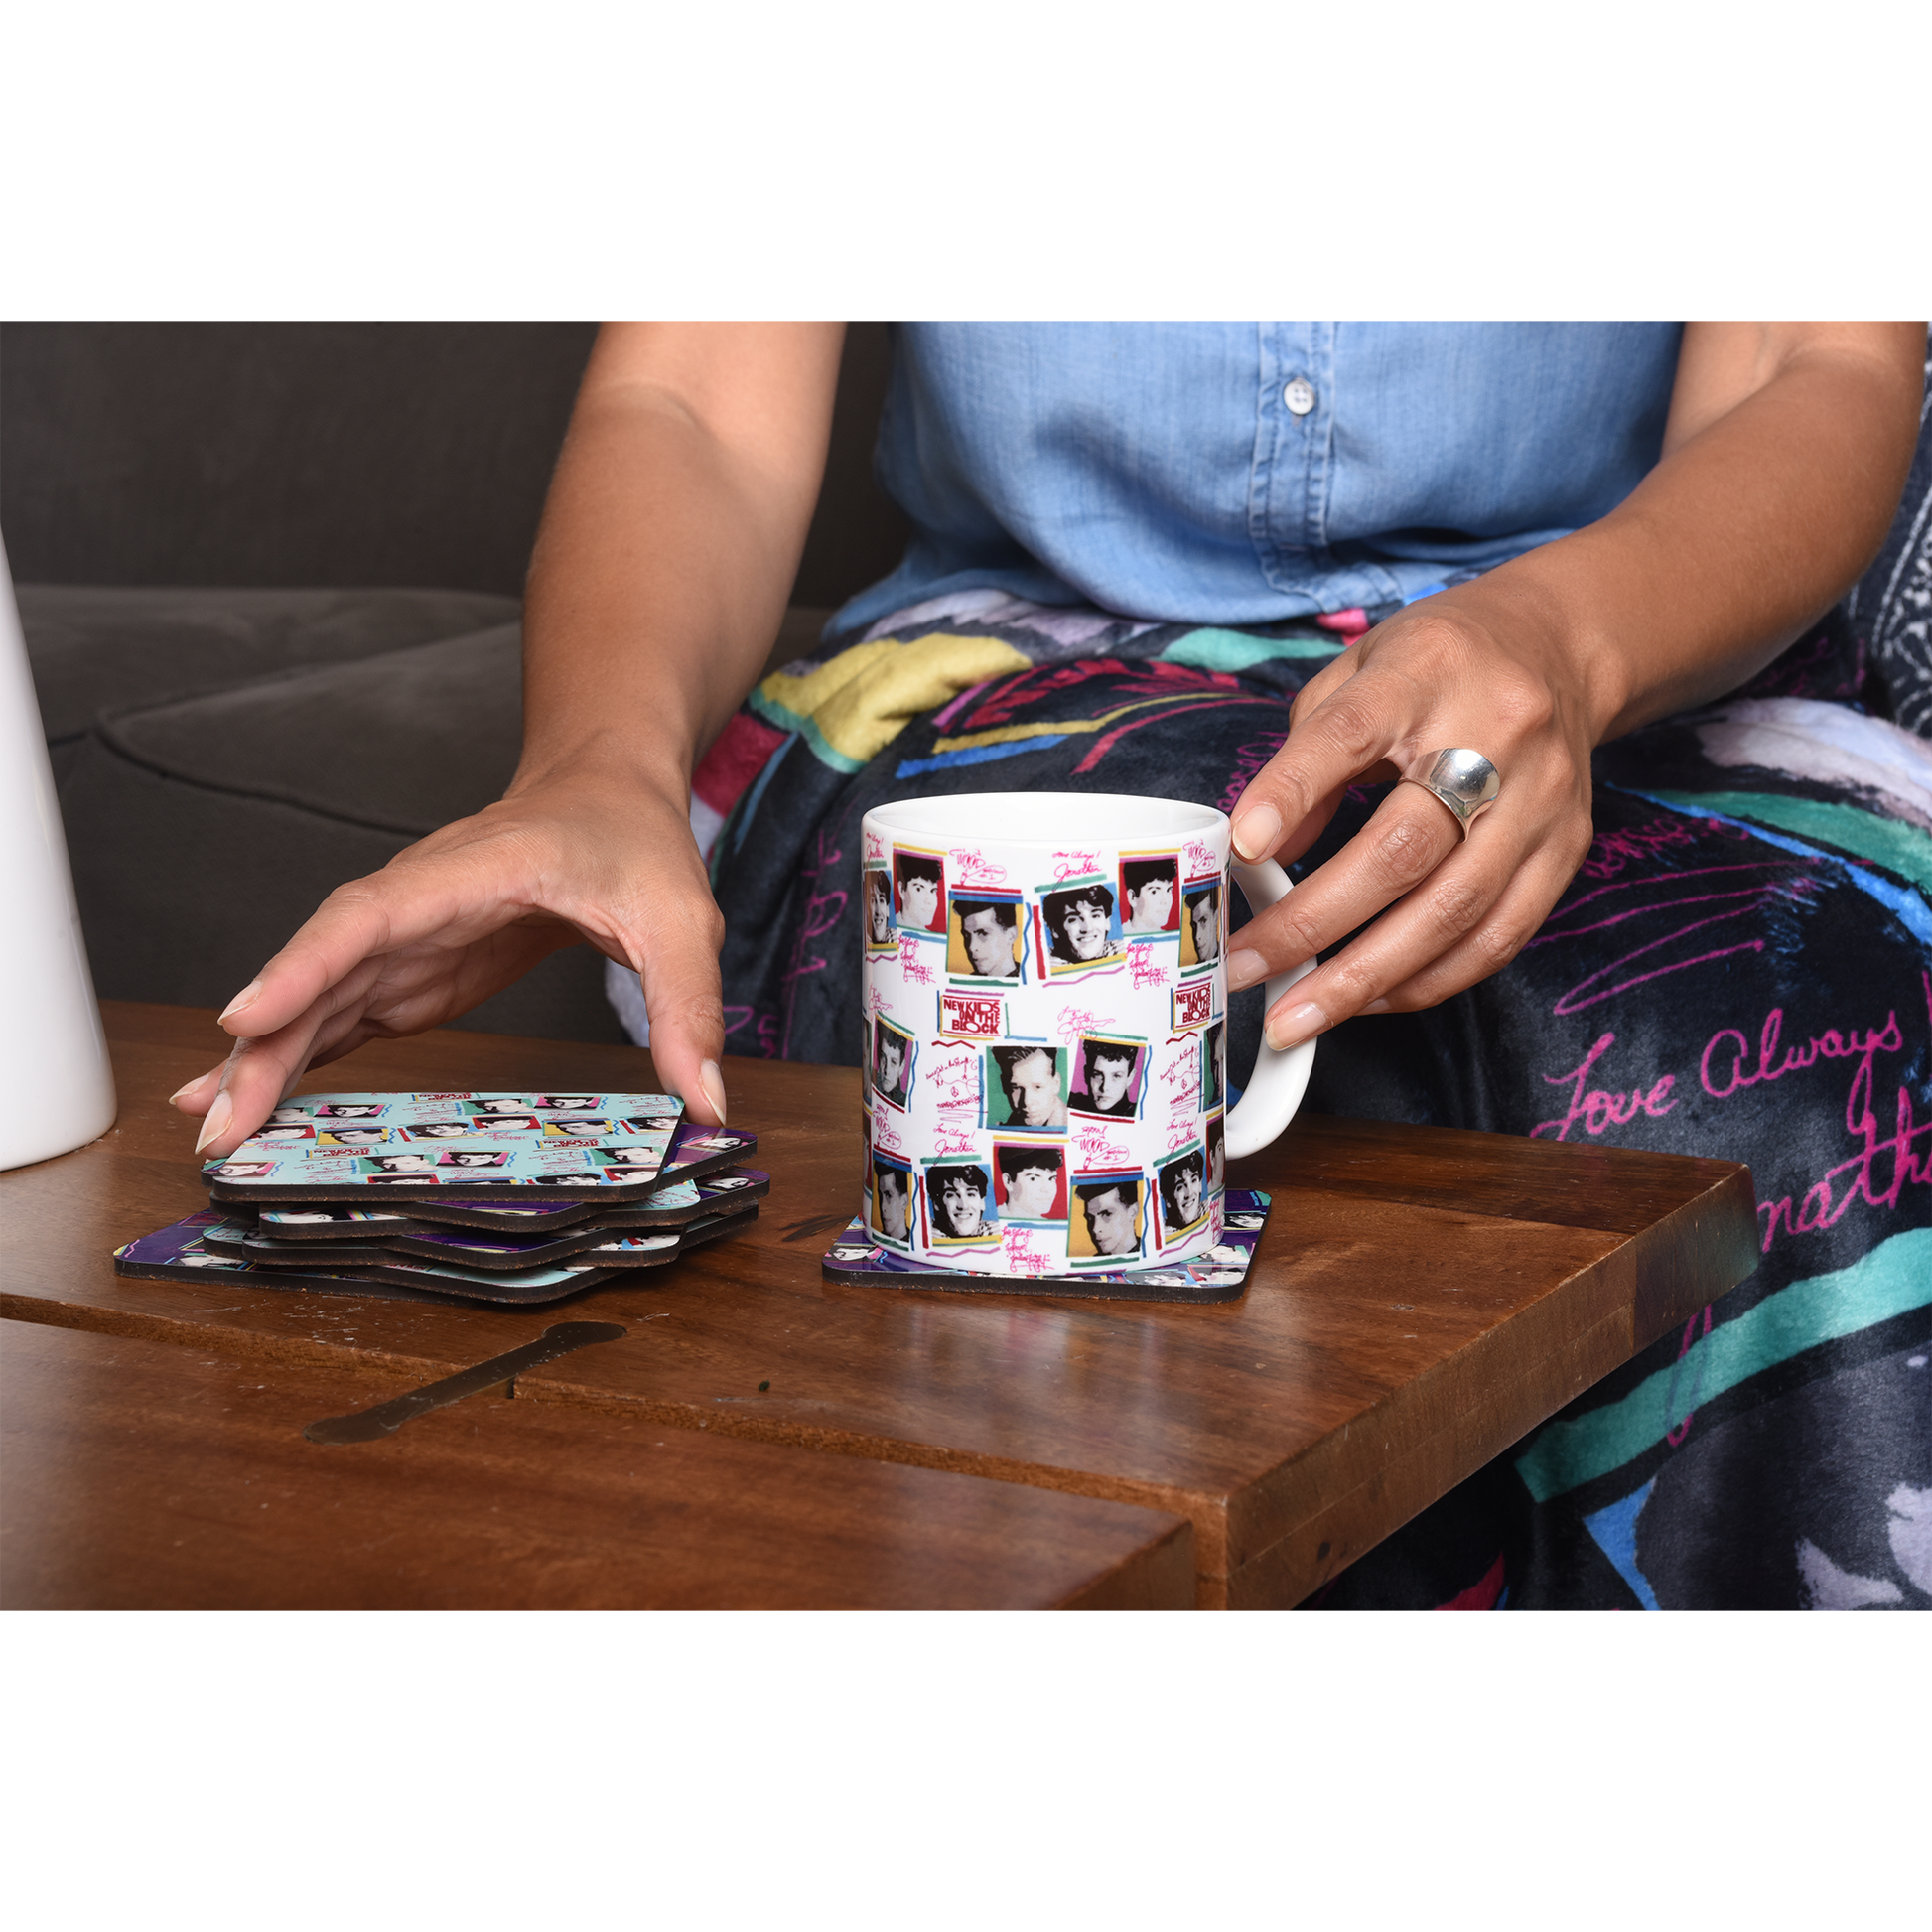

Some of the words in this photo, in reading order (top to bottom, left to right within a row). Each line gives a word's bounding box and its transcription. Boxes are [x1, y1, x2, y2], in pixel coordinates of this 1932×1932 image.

[943, 999, 964, 1011] NEW
[965, 1000, 1001, 1013] KIDS
[1176, 993, 1191, 1005] NEW
[959, 1010, 975, 1023] ON
[977, 1011, 1001, 1024] THE
[951, 1019, 1000, 1035] BLOCK
[1530, 1033, 1679, 1141] Love
